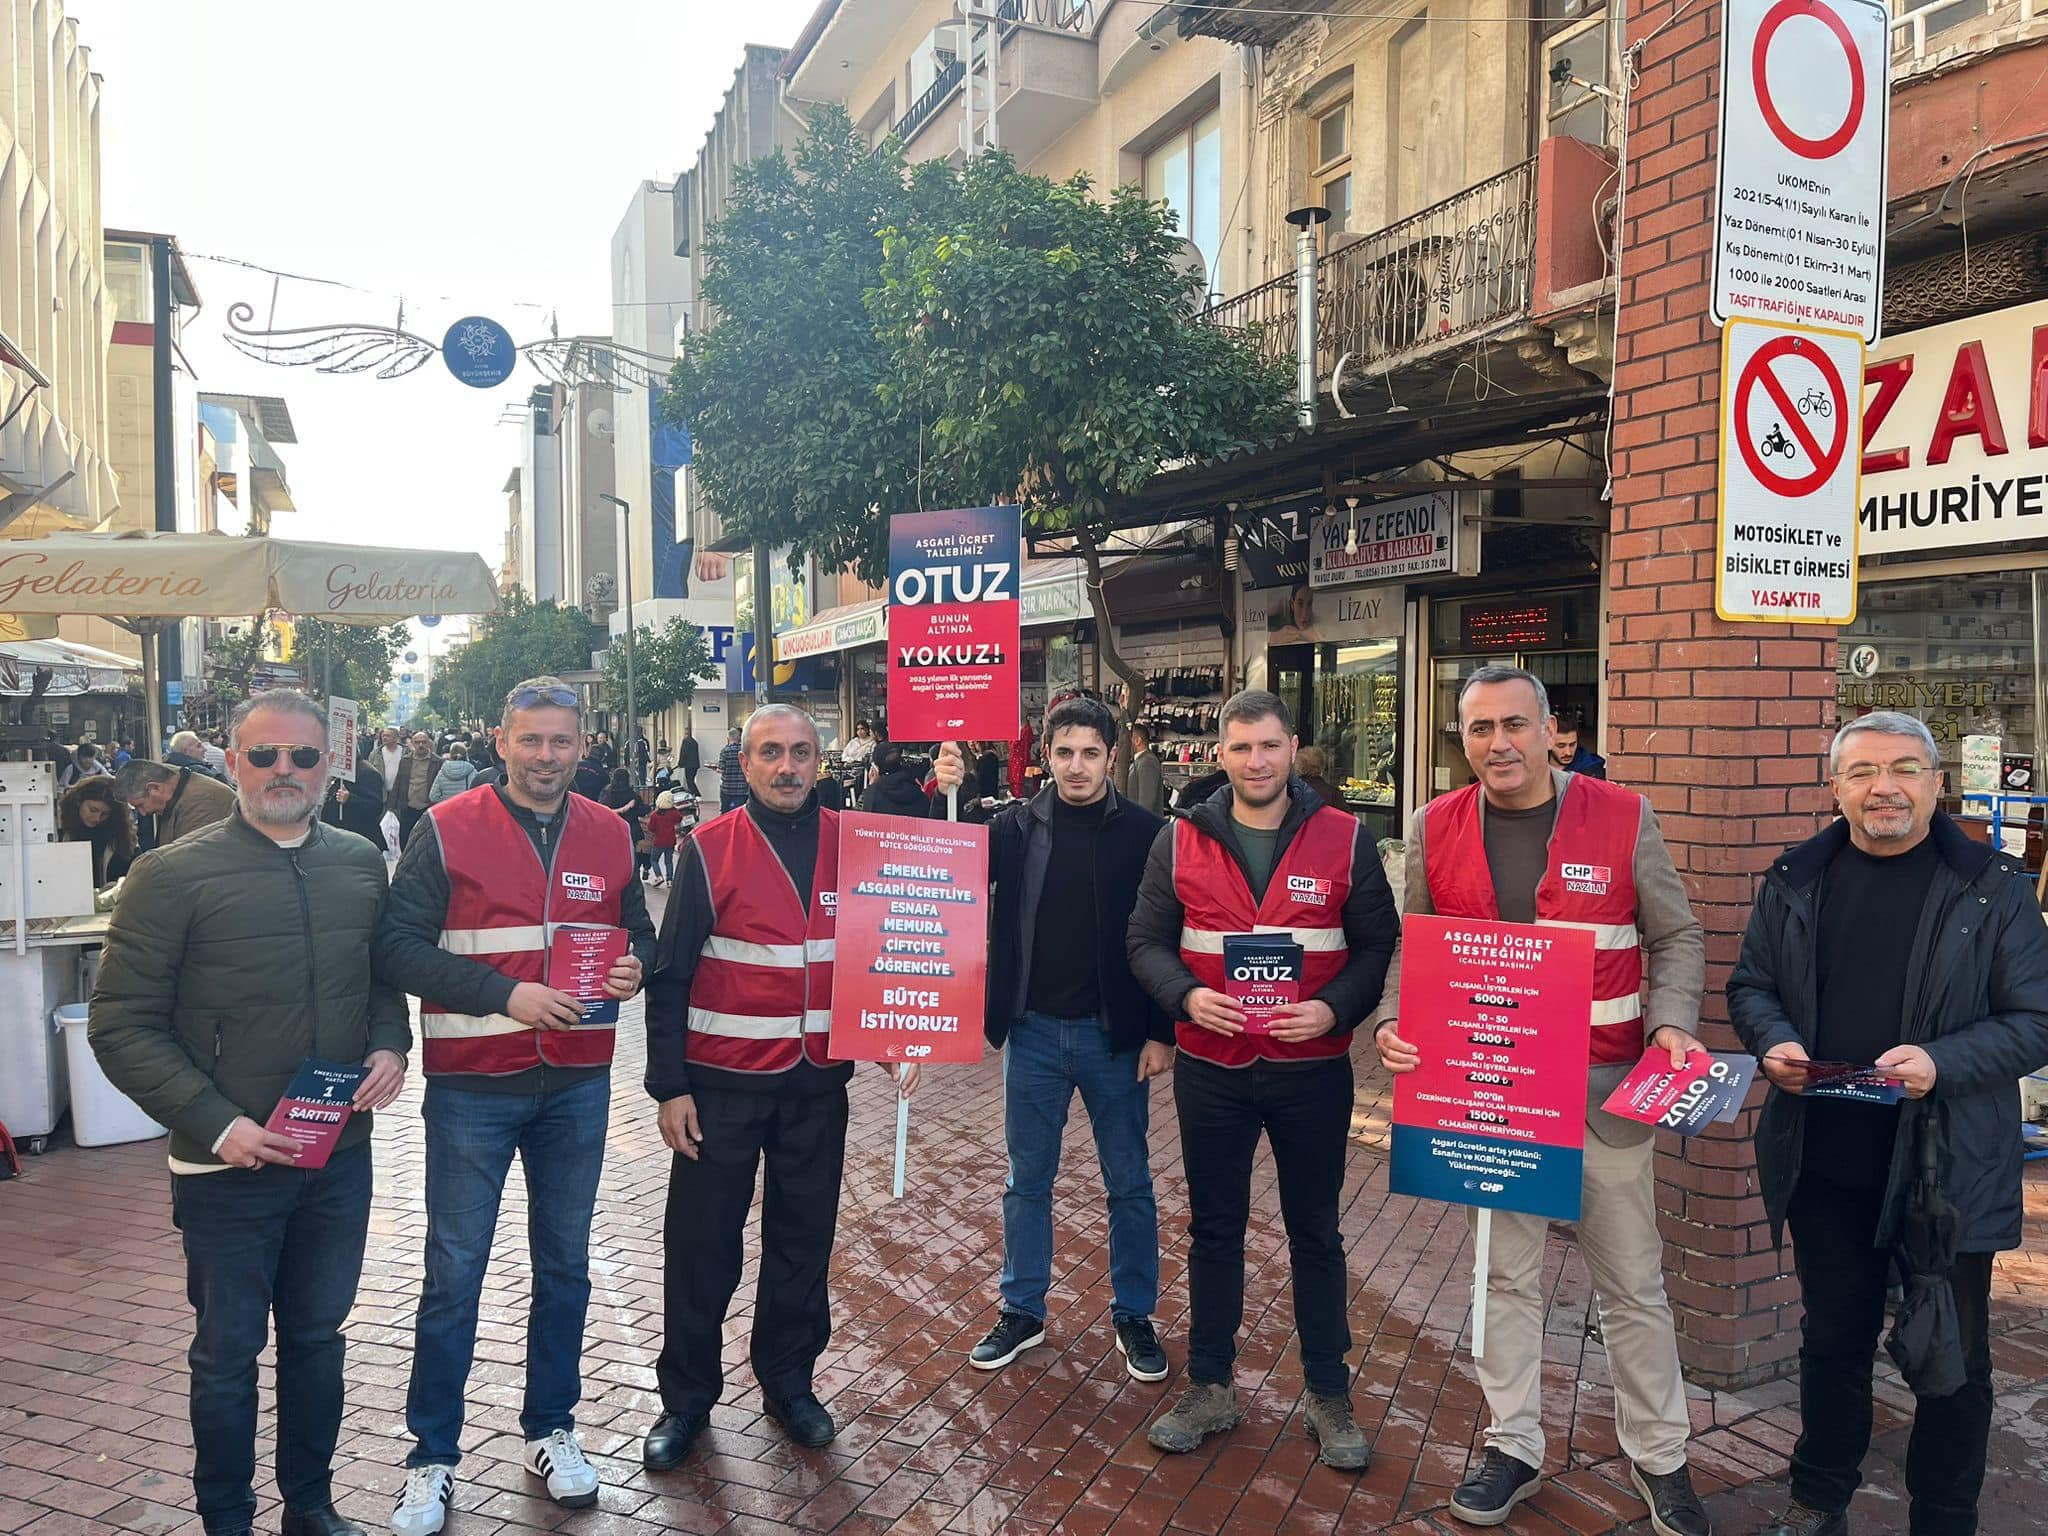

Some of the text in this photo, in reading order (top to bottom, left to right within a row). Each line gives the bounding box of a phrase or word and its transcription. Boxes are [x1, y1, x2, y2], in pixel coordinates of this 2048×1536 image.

[1724, 214, 1743, 229] Yaz
[1726, 241, 1741, 256] Kış
[1761, 274, 1772, 286] ile
[1806, 282, 1842, 299] Saatleri
[1843, 289, 1866, 303] Arası
[1729, 293, 1864, 327] TAŞIT TRAFİĞİNE KAPALIDIR
[1375, 499, 1436, 541] EFENDİ
[915, 534, 995, 548] ASGARİ ÜCRET
[1734, 523, 1841, 547] MOTOSİKLET ve
[926, 545, 983, 558] TALEBİMİZ
[1387, 535, 1431, 560] BAHARAT
[1726, 552, 1850, 579] BİSİKLET GİRMESİ
[0, 552, 209, 606] Gelateria
[895, 562, 1010, 606] OTUZ
[325, 563, 458, 611] Gelateria
[1752, 590, 1821, 609] YASAKTIR
[1338, 597, 1381, 622] LİZAY
[931, 613, 969, 624] BUNUN
[927, 625, 973, 635] ALTINDA
[900, 643, 1000, 666] YOKUZ!
[947, 719, 964, 727] CHP
[855, 829, 884, 839] TÜRKİYE
[886, 831, 909, 841] BÜYÜK
[911, 835, 934, 843] MİLLET
[883, 863, 948, 880] EMEKLİYE
[1564, 866, 1590, 877] CHP
[565, 875, 588, 886] CHP
[1290, 878, 1314, 889] CHP
[822, 894, 837, 903] CH
[858, 881, 972, 901] ASGARİ ÜCRETLİYE
[890, 901, 938, 916] ESNAFA
[884, 917, 943, 934] MEMURA
[886, 937, 941, 954] ÇİFTÇİYE
[1444, 931, 1553, 950] ASGARİ ÜCRET
[1452, 944, 1543, 962] DESTEĞİNİN
[874, 956, 950, 975] ÖĞRENCİYE
[1233, 966, 1293, 981] OTUZ
[1496, 976, 1507, 984] 10
[1449, 981, 1486, 991] ÇALIŞANLI
[1523, 987, 1539, 997] İÇİN
[883, 986, 939, 1009] BÜTÇE
[1237, 995, 1289, 1006] YOKUZ!
[860, 1009, 959, 1032] İSTİYORUZ!
[1478, 1013, 1508, 1024] 10 50
[1448, 1020, 1484, 1030] ÇALIŞANLI
[1522, 1026, 1538, 1036] İÇİN
[1472, 1032, 1502, 1044] 3000
[905, 1045, 932, 1057] CHP
[1471, 1052, 1509, 1064] 50 100
[1446, 1058, 1482, 1069] ÇALIŞANLI
[1470, 1071, 1500, 1083] 2000
[323, 1086, 334, 1098] 1
[1416, 1092, 1452, 1104] ÜZERİNDE
[1486, 1102, 1506, 1110] OLAN
[1544, 1107, 1560, 1118] İÇİN
[1658, 1080, 1709, 1127] OTUZ
[288, 1106, 341, 1122] ŞARTTIR
[1470, 1110, 1497, 1122] 1500
[1438, 1119, 1478, 1131] OLMASINI
[1430, 1138, 1457, 1149] Asgari
[1458, 1142, 1487, 1153] ücretin
[1432, 1148, 1462, 1159] Esnafın
[1463, 1153, 1473, 1161] ve
[1480, 1181, 1504, 1193] CHP
